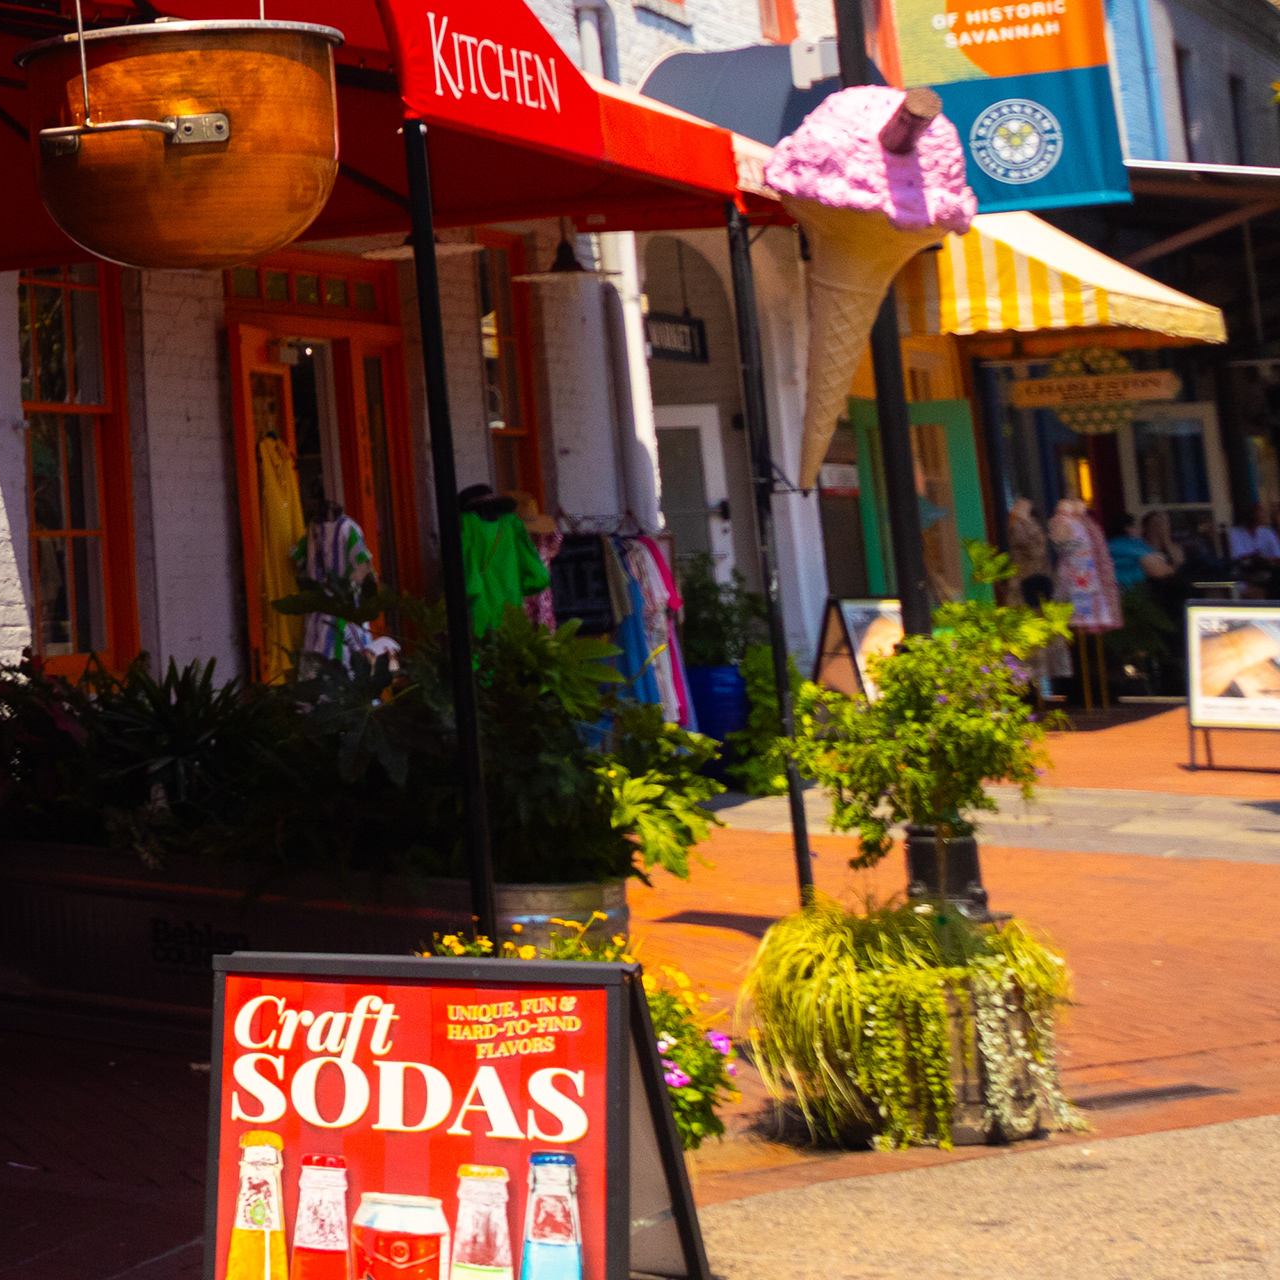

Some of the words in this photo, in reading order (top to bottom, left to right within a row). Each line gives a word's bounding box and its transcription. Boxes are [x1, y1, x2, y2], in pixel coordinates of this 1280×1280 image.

[931, 12, 958, 31] OF
[944, 21, 1061, 49] SAVANNAH
[425, 10, 561, 115] KITCHEN
[447, 1001, 519, 1023] UNIQUE,
[521, 996, 557, 1015] FUN
[558, 996, 577, 1012] &
[233, 994, 400, 1060] Craft
[446, 1015, 582, 1040] HARD-TO-FIND
[475, 1035, 556, 1060] FLAVORS
[231, 1052, 589, 1143] SODAS
